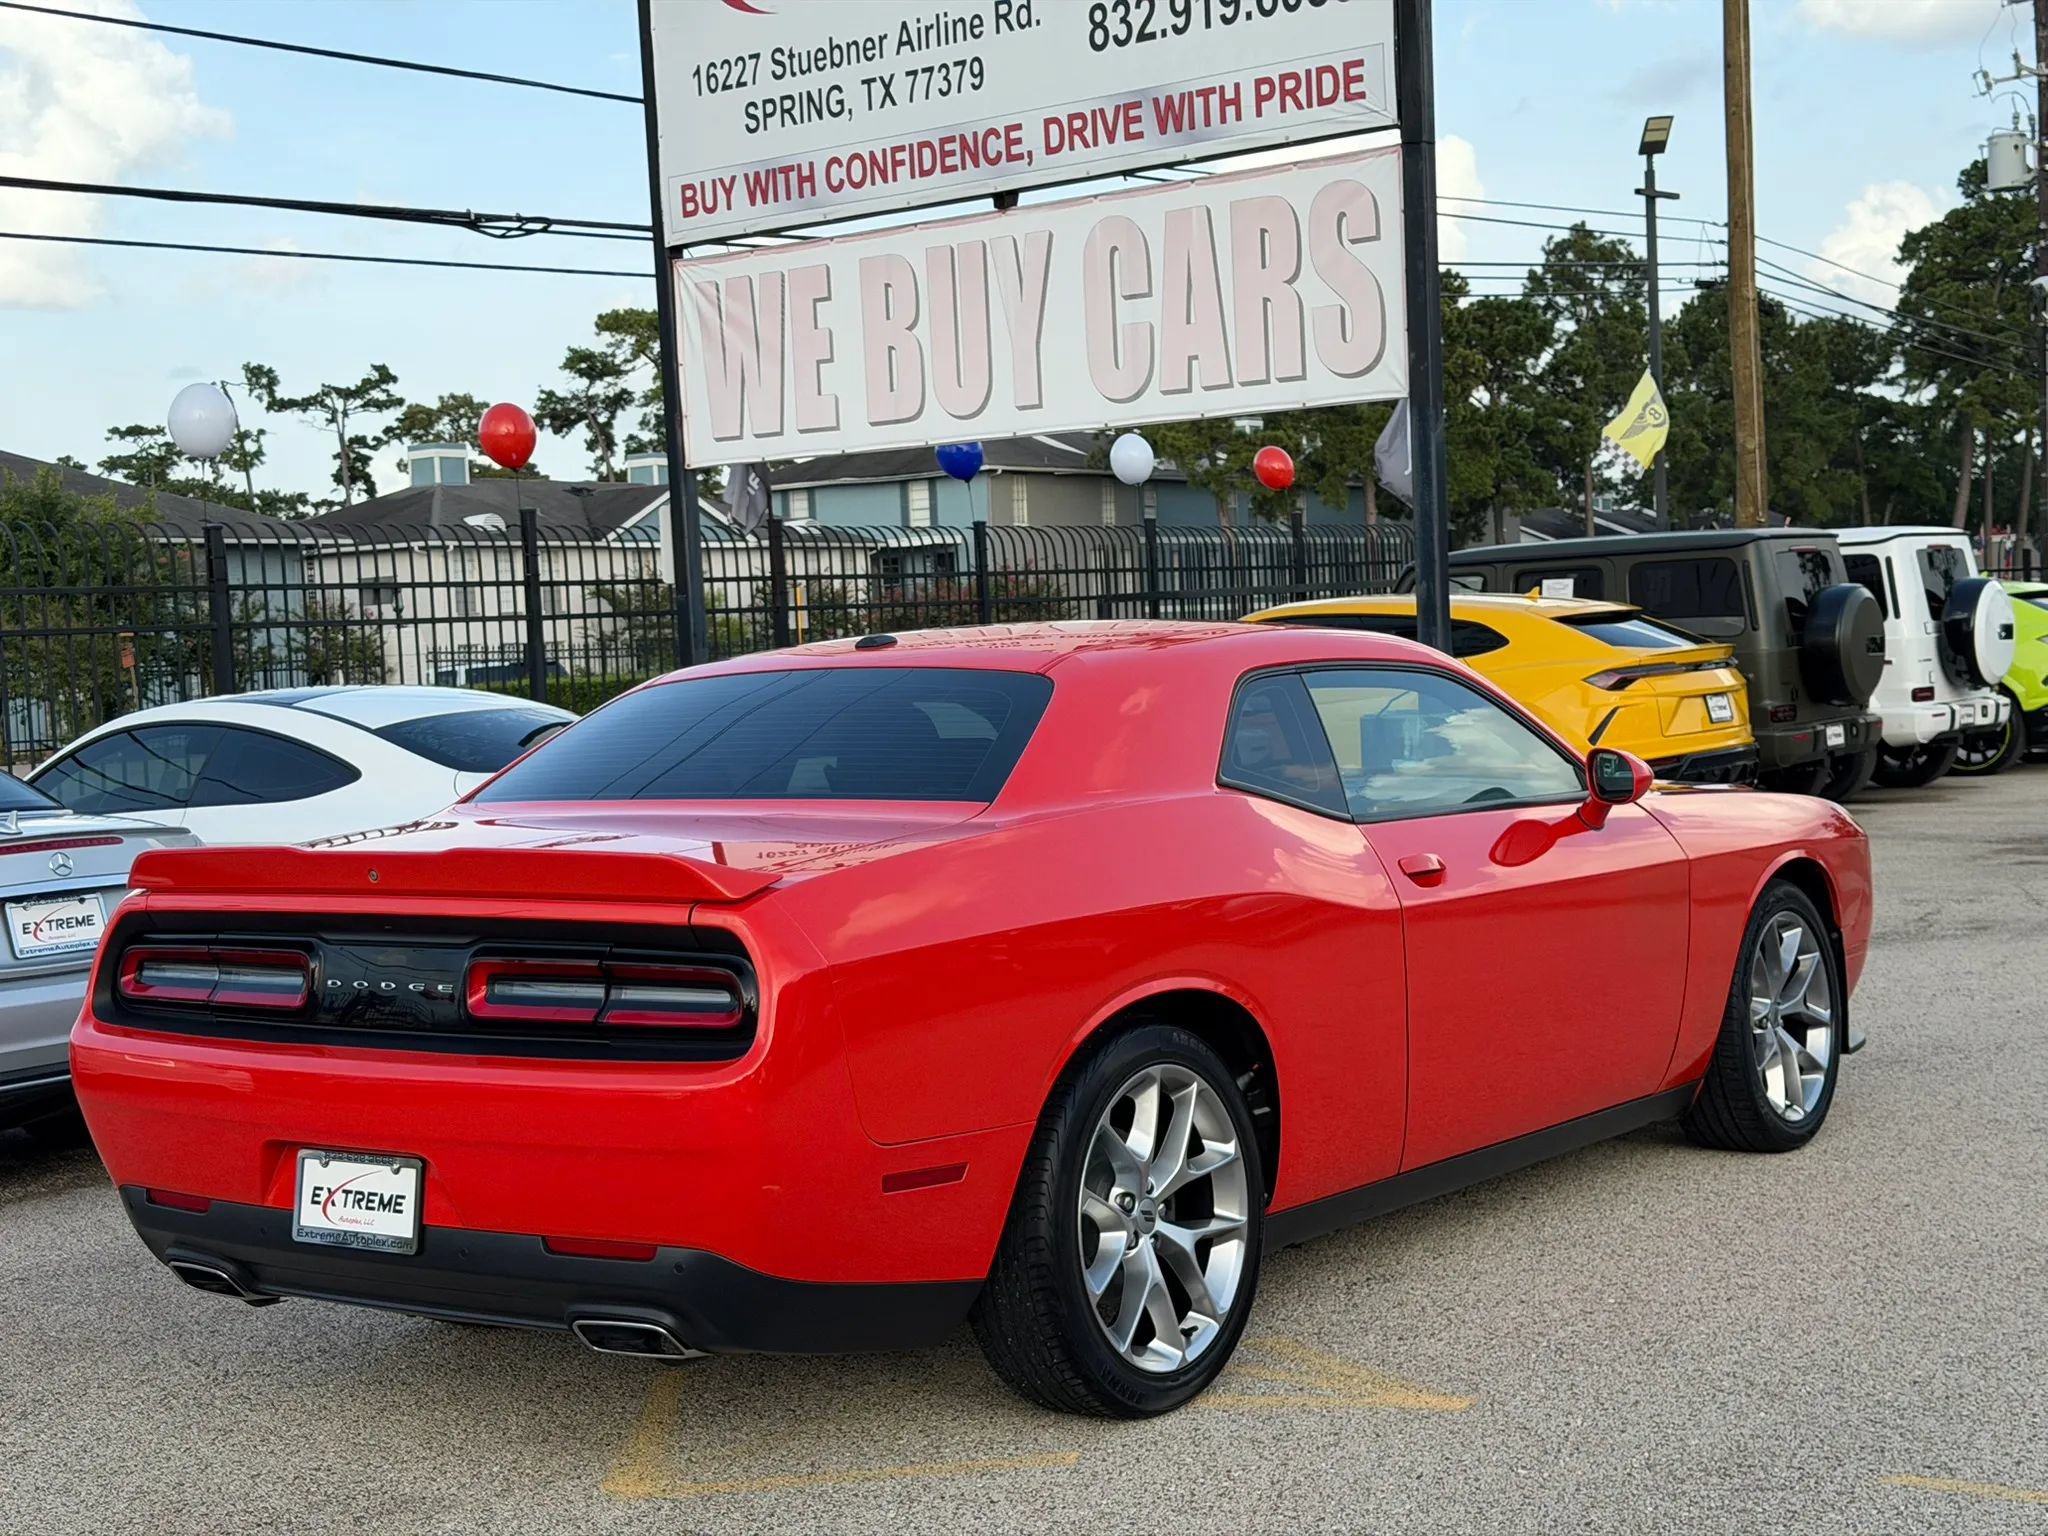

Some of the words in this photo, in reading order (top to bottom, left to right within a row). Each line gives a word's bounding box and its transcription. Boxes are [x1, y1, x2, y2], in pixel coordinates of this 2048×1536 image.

[692, 52, 761, 97] 16227
[771, 33, 888, 81] Stuebner
[896, 11, 984, 56] Airline
[994, 0, 1041, 35] Rd.
[1088, 0, 1351, 52] 832.919.
[744, 84, 853, 134] SPRING,
[861, 73, 898, 111] TX
[905, 56, 985, 104] 77379
[681, 174, 737, 218] BUY
[744, 161, 816, 207] WITH
[825, 123, 1033, 194] CONFIDENCE,
[1043, 100, 1145, 156] DRIVE
[1152, 82, 1242, 136] WITH
[1254, 58, 1367, 118] PRIDE
[698, 264, 840, 442] WE
[858, 230, 1053, 426] BUY
[1082, 178, 1386, 404] CARS
[22, 914, 96, 935] EXTREME
[327, 979, 454, 993] DODGE
[310, 1185, 406, 1214] EXTREME
